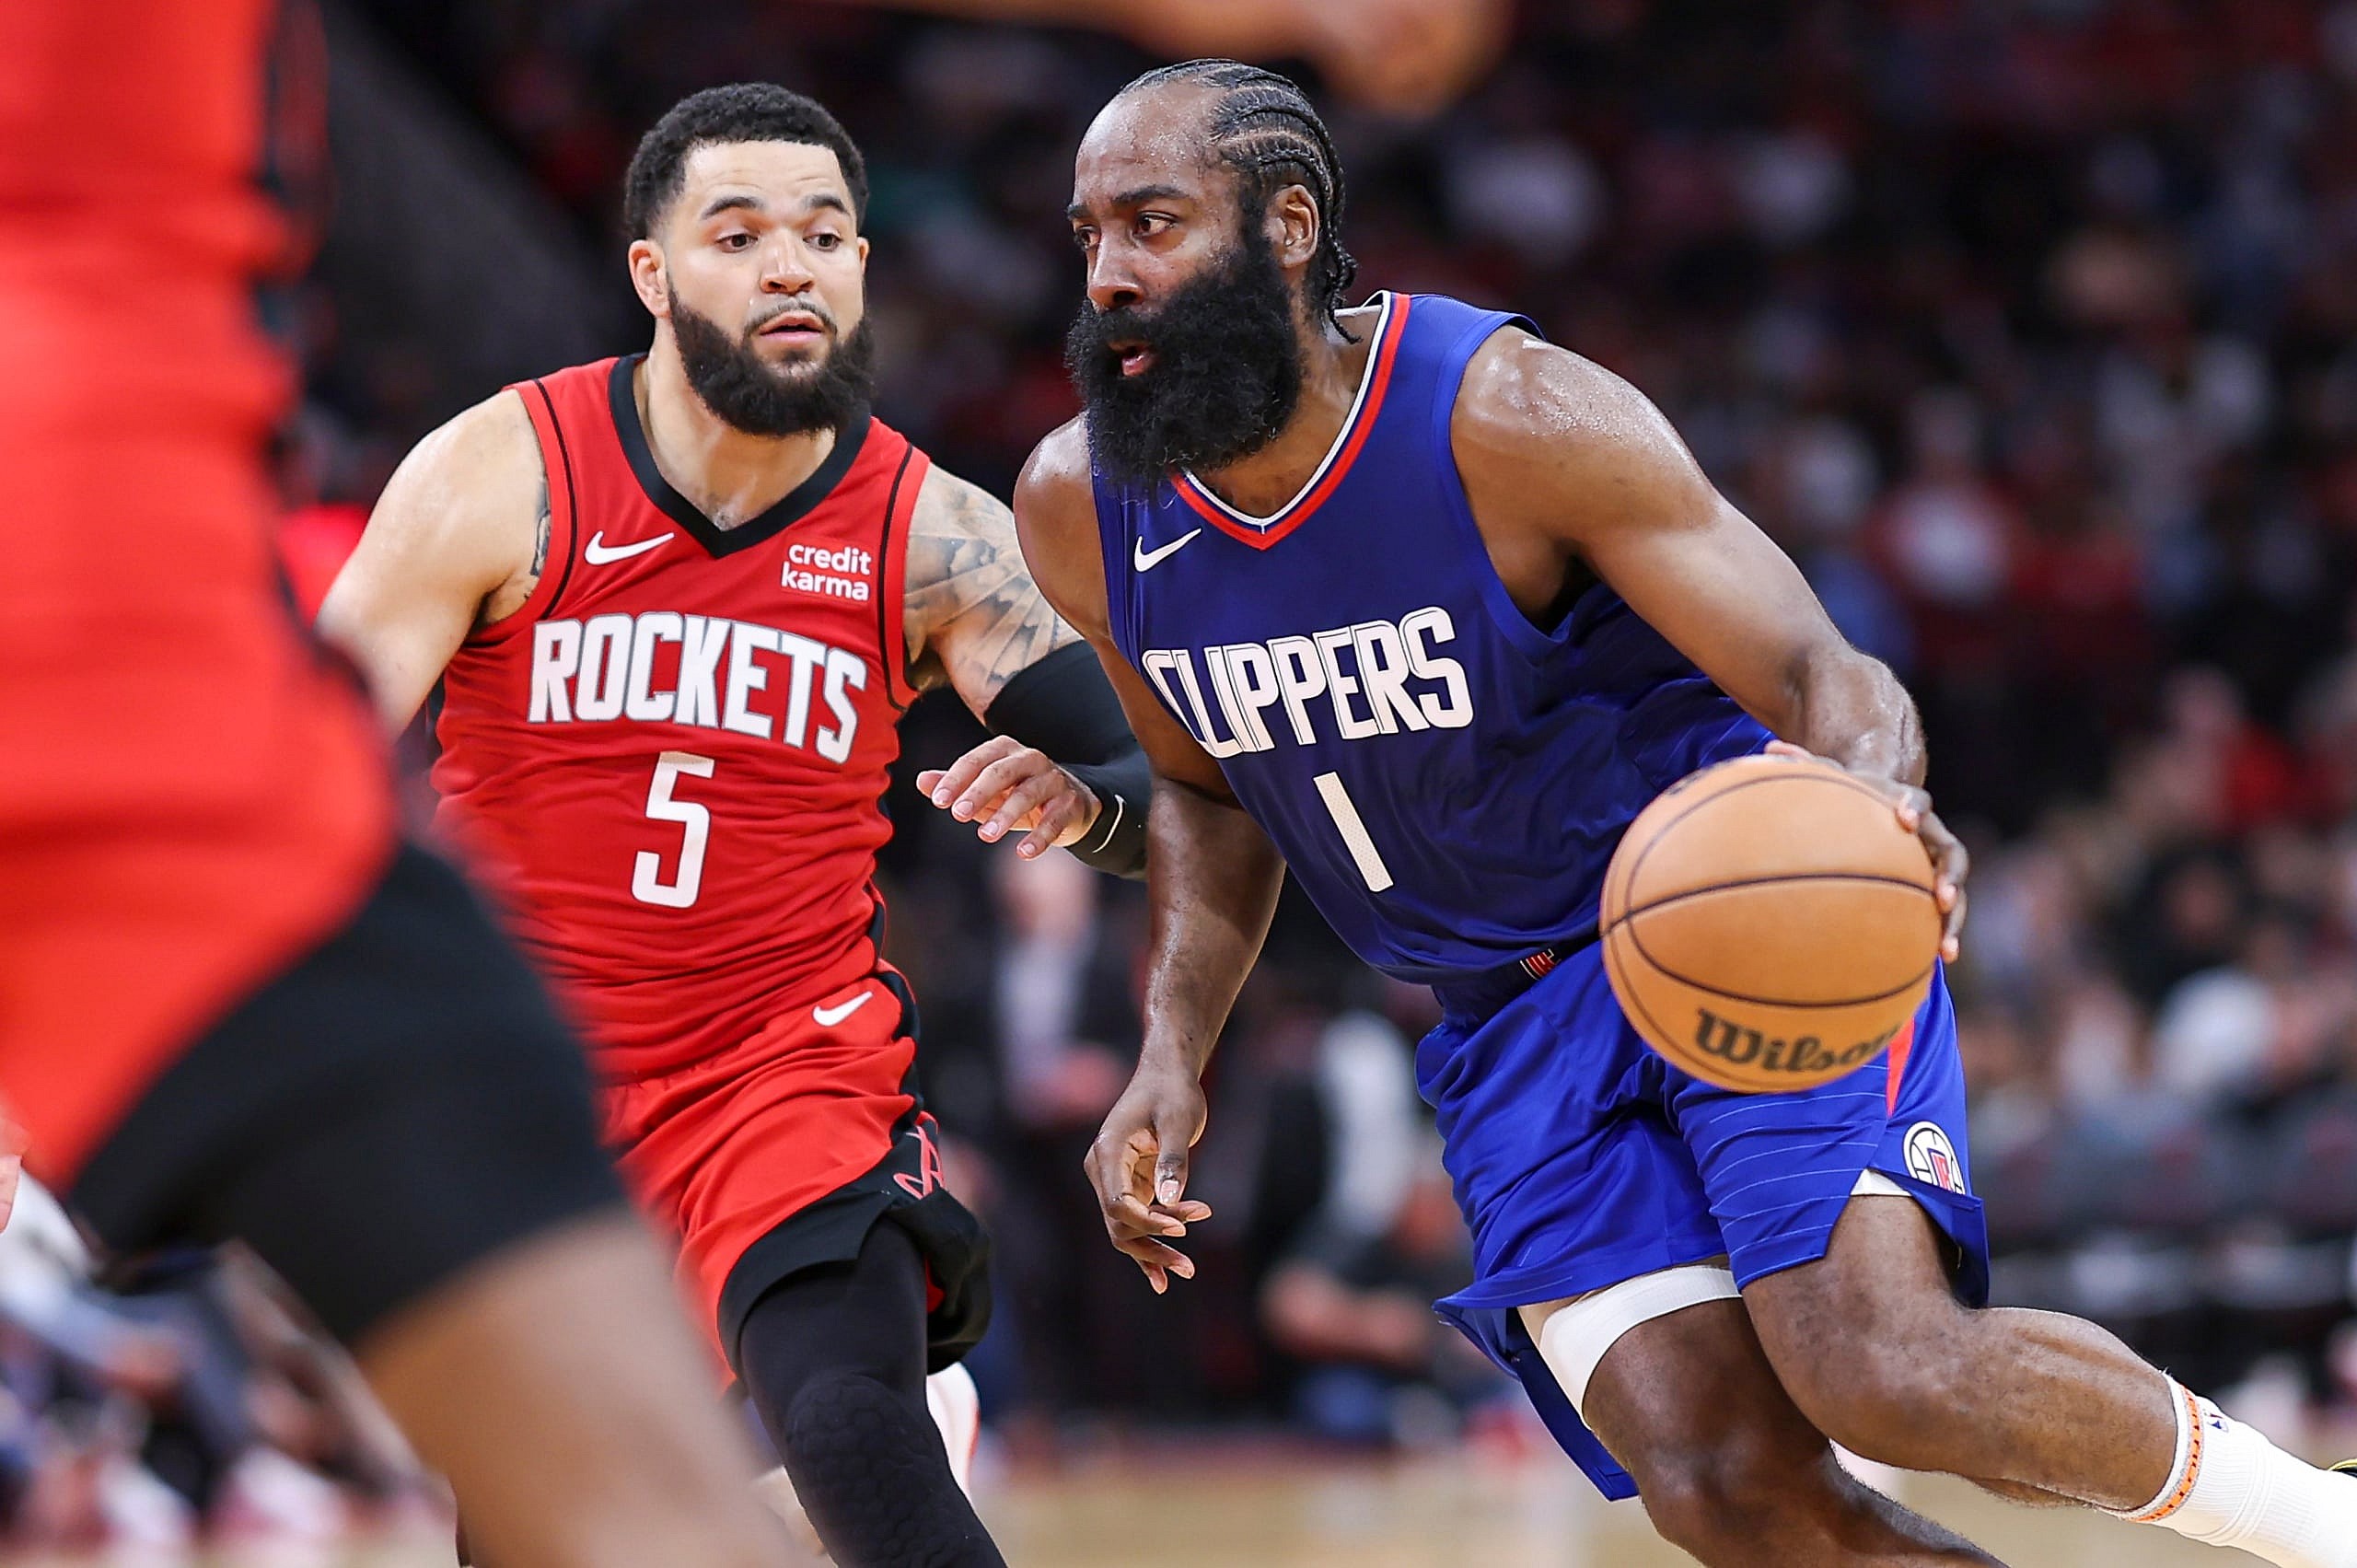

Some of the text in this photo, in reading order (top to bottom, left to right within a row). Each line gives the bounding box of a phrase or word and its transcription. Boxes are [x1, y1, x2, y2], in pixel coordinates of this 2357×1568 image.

[781, 561, 869, 601] karma
[788, 543, 872, 575] credit
[528, 610, 868, 764] ROCKETS
[1142, 606, 1474, 759] CLIPPERS
[632, 751, 714, 909] 5
[1313, 771, 1394, 892] 1
